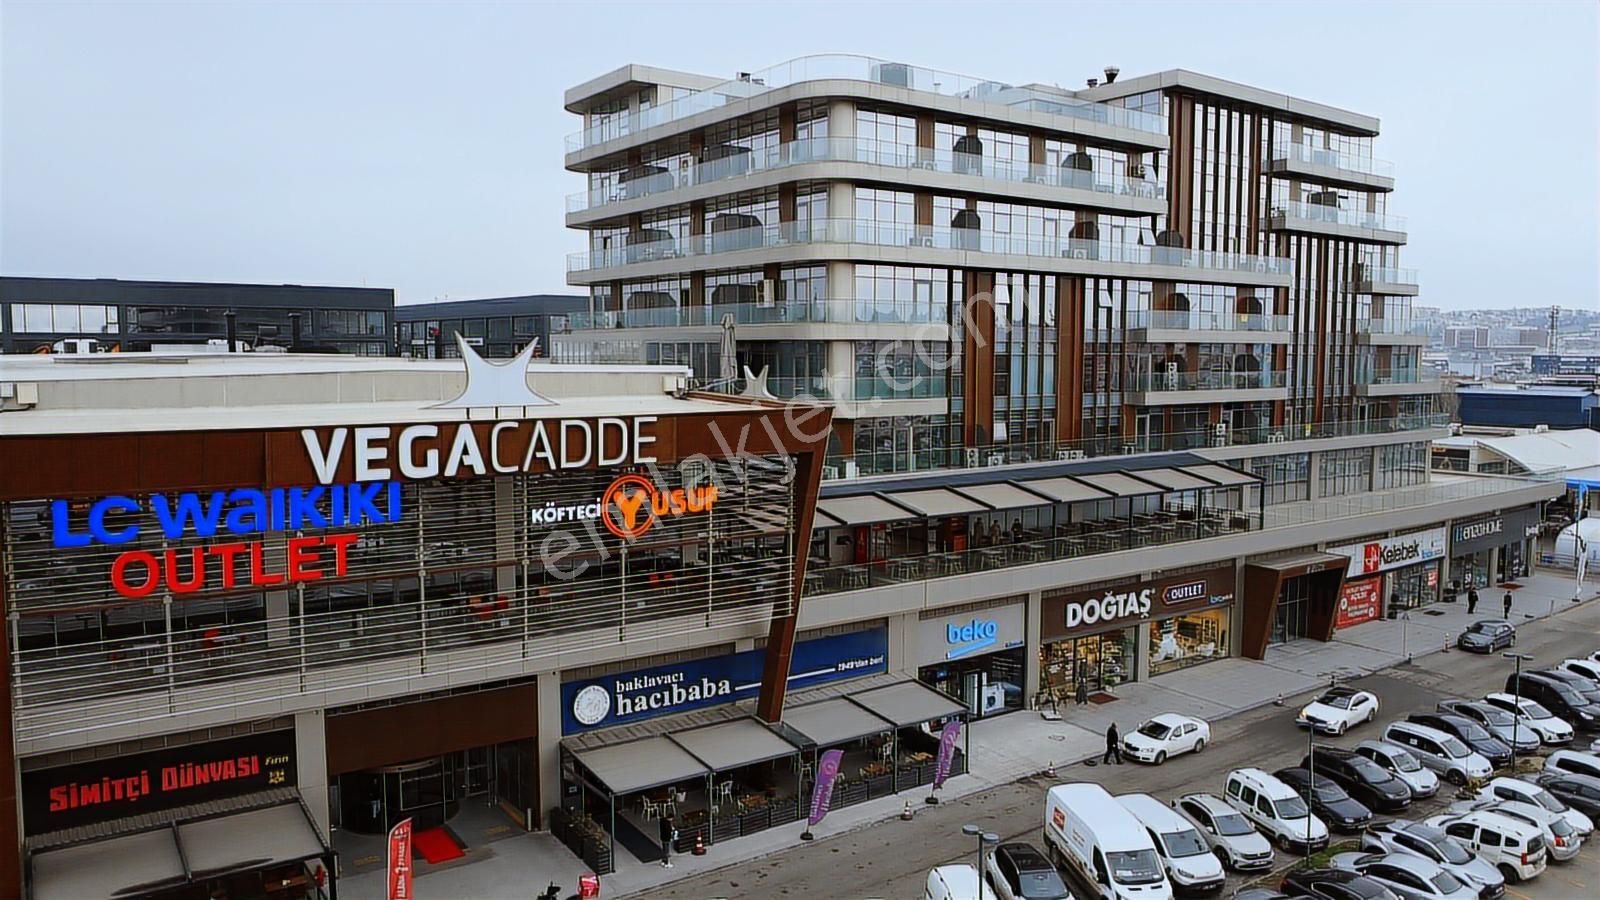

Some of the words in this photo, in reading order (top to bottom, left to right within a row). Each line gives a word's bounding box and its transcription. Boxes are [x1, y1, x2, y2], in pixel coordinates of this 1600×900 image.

[301, 416, 658, 485] VEGACADDE
[51, 495, 141, 548] LC
[531, 498, 602, 524] KÖFTECİ
[610, 484, 719, 531] YUSUF
[111, 534, 358, 598] OUTLET
[1380, 540, 1419, 564] Kelebek
[1066, 588, 1151, 627] DOĞTAŞ
[1171, 584, 1202, 599] OUTLET
[946, 620, 997, 644] beko
[616, 673, 684, 692] baklavacı
[616, 678, 730, 716] hacıbaba
[162, 755, 260, 791] DÜNYASI
